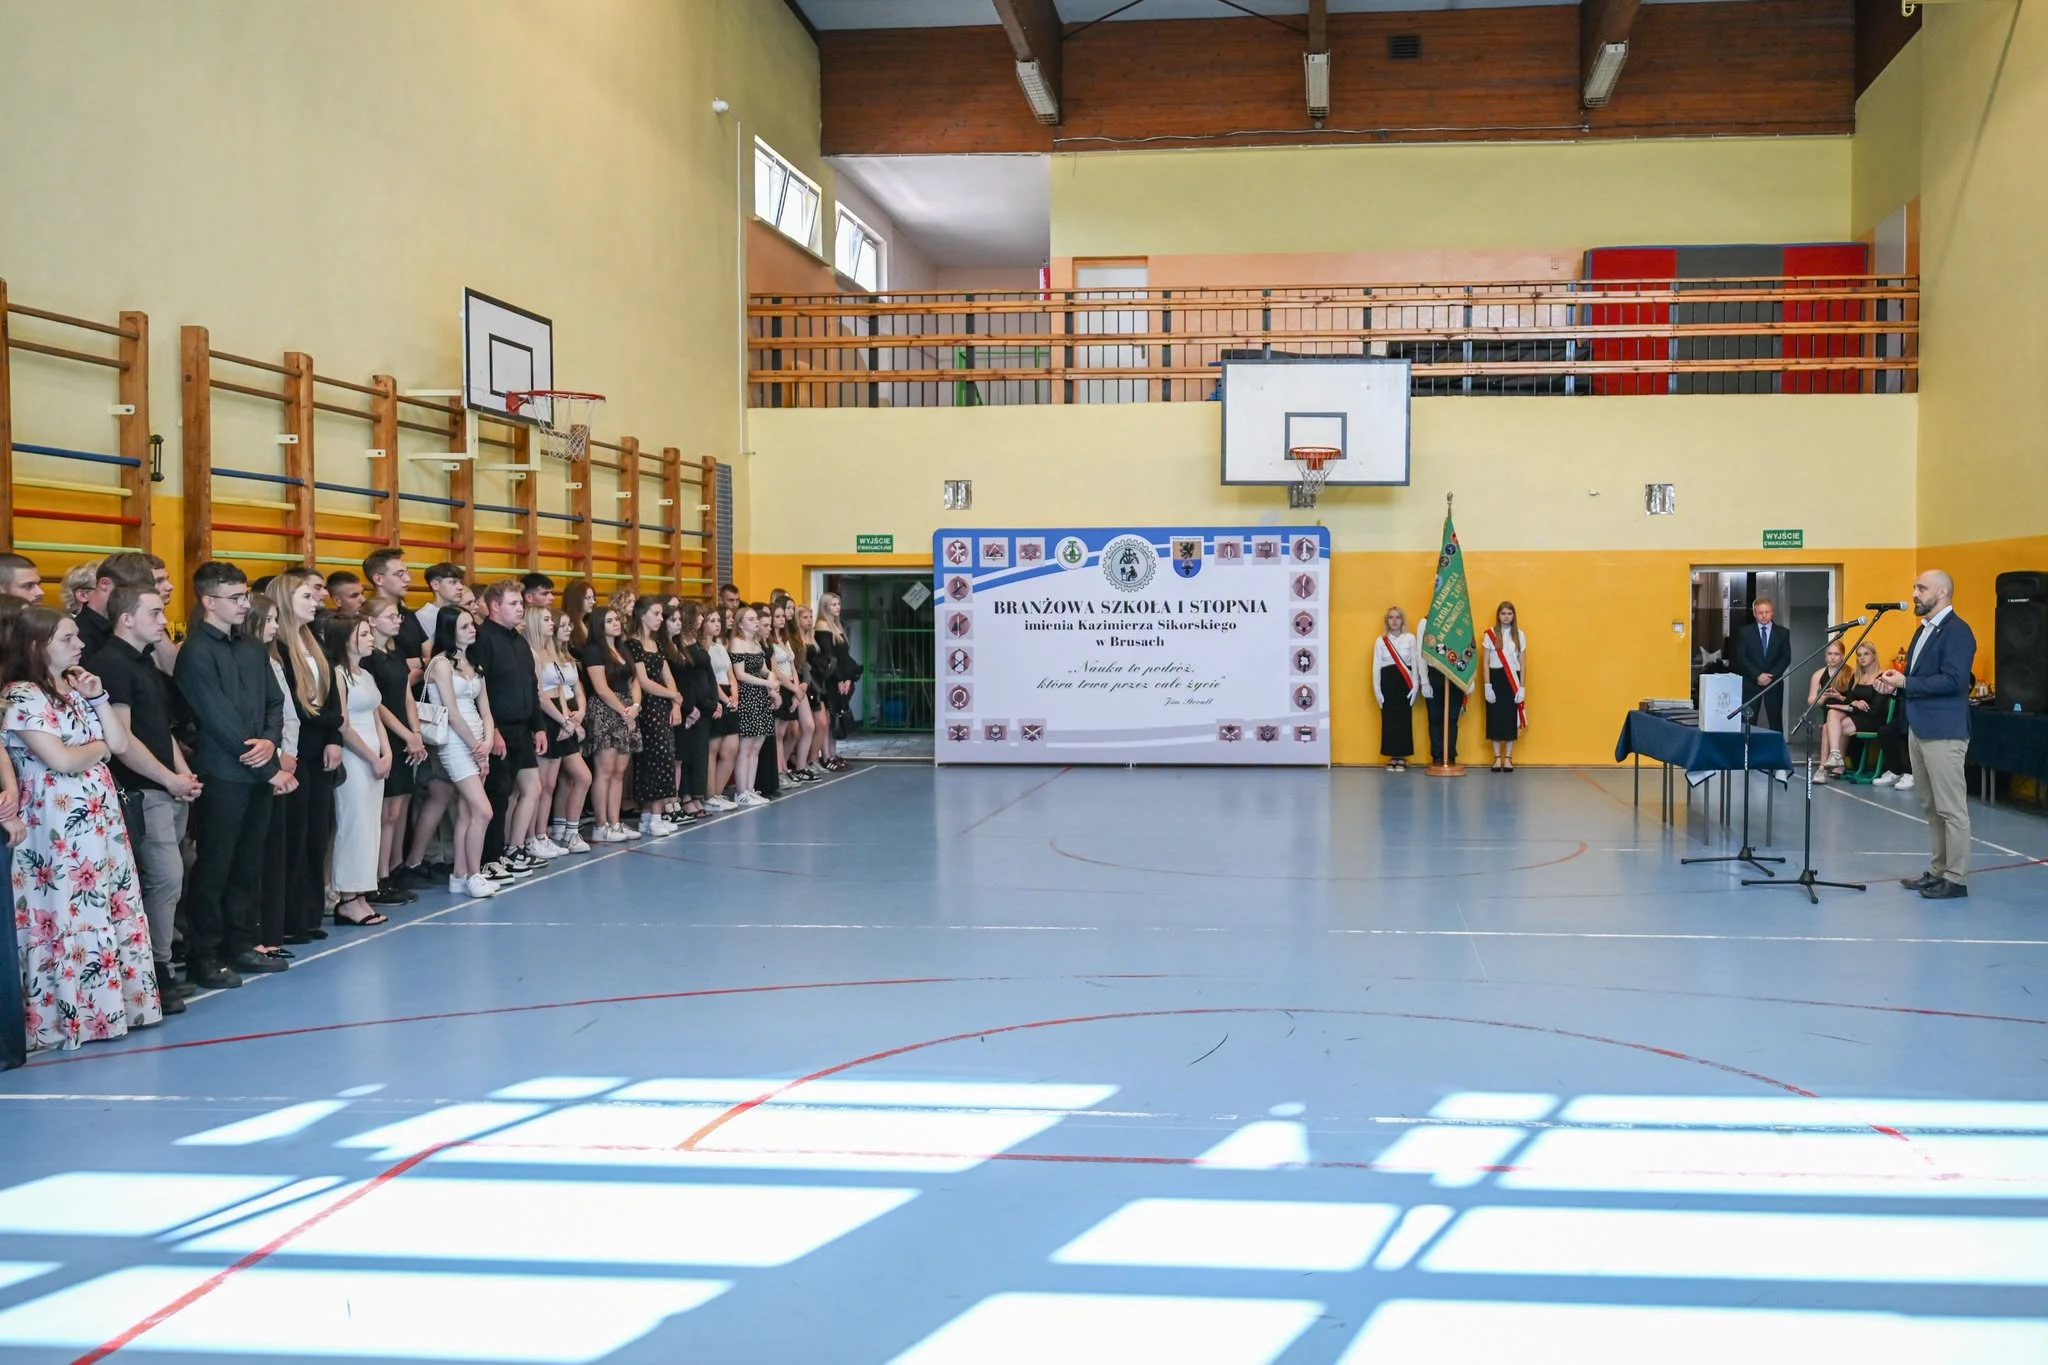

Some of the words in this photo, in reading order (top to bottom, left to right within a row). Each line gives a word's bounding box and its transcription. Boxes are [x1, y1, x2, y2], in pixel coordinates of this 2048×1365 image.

[859, 537, 891, 545] WYJŚCIE
[1765, 532, 1800, 540] WYJŚCIE
[994, 597, 1095, 615] BRANŻOWA
[1101, 599, 1171, 615] SZKOŁA
[1178, 600, 1184, 614] I
[1190, 599, 1268, 614] STOPNIA
[1024, 619, 1074, 631] imienia
[1078, 619, 1153, 631] Kazimierza
[1158, 619, 1237, 632] Sikorskiego
[1096, 638, 1106, 647] w
[1110, 636, 1165, 647] Brusach
[1128, 663, 1141, 673] to
[1036, 677, 1073, 689] która
[1077, 679, 1109, 689] trwa
[1109, 680, 1149, 692] przez
[1154, 676, 1182, 689] całe
